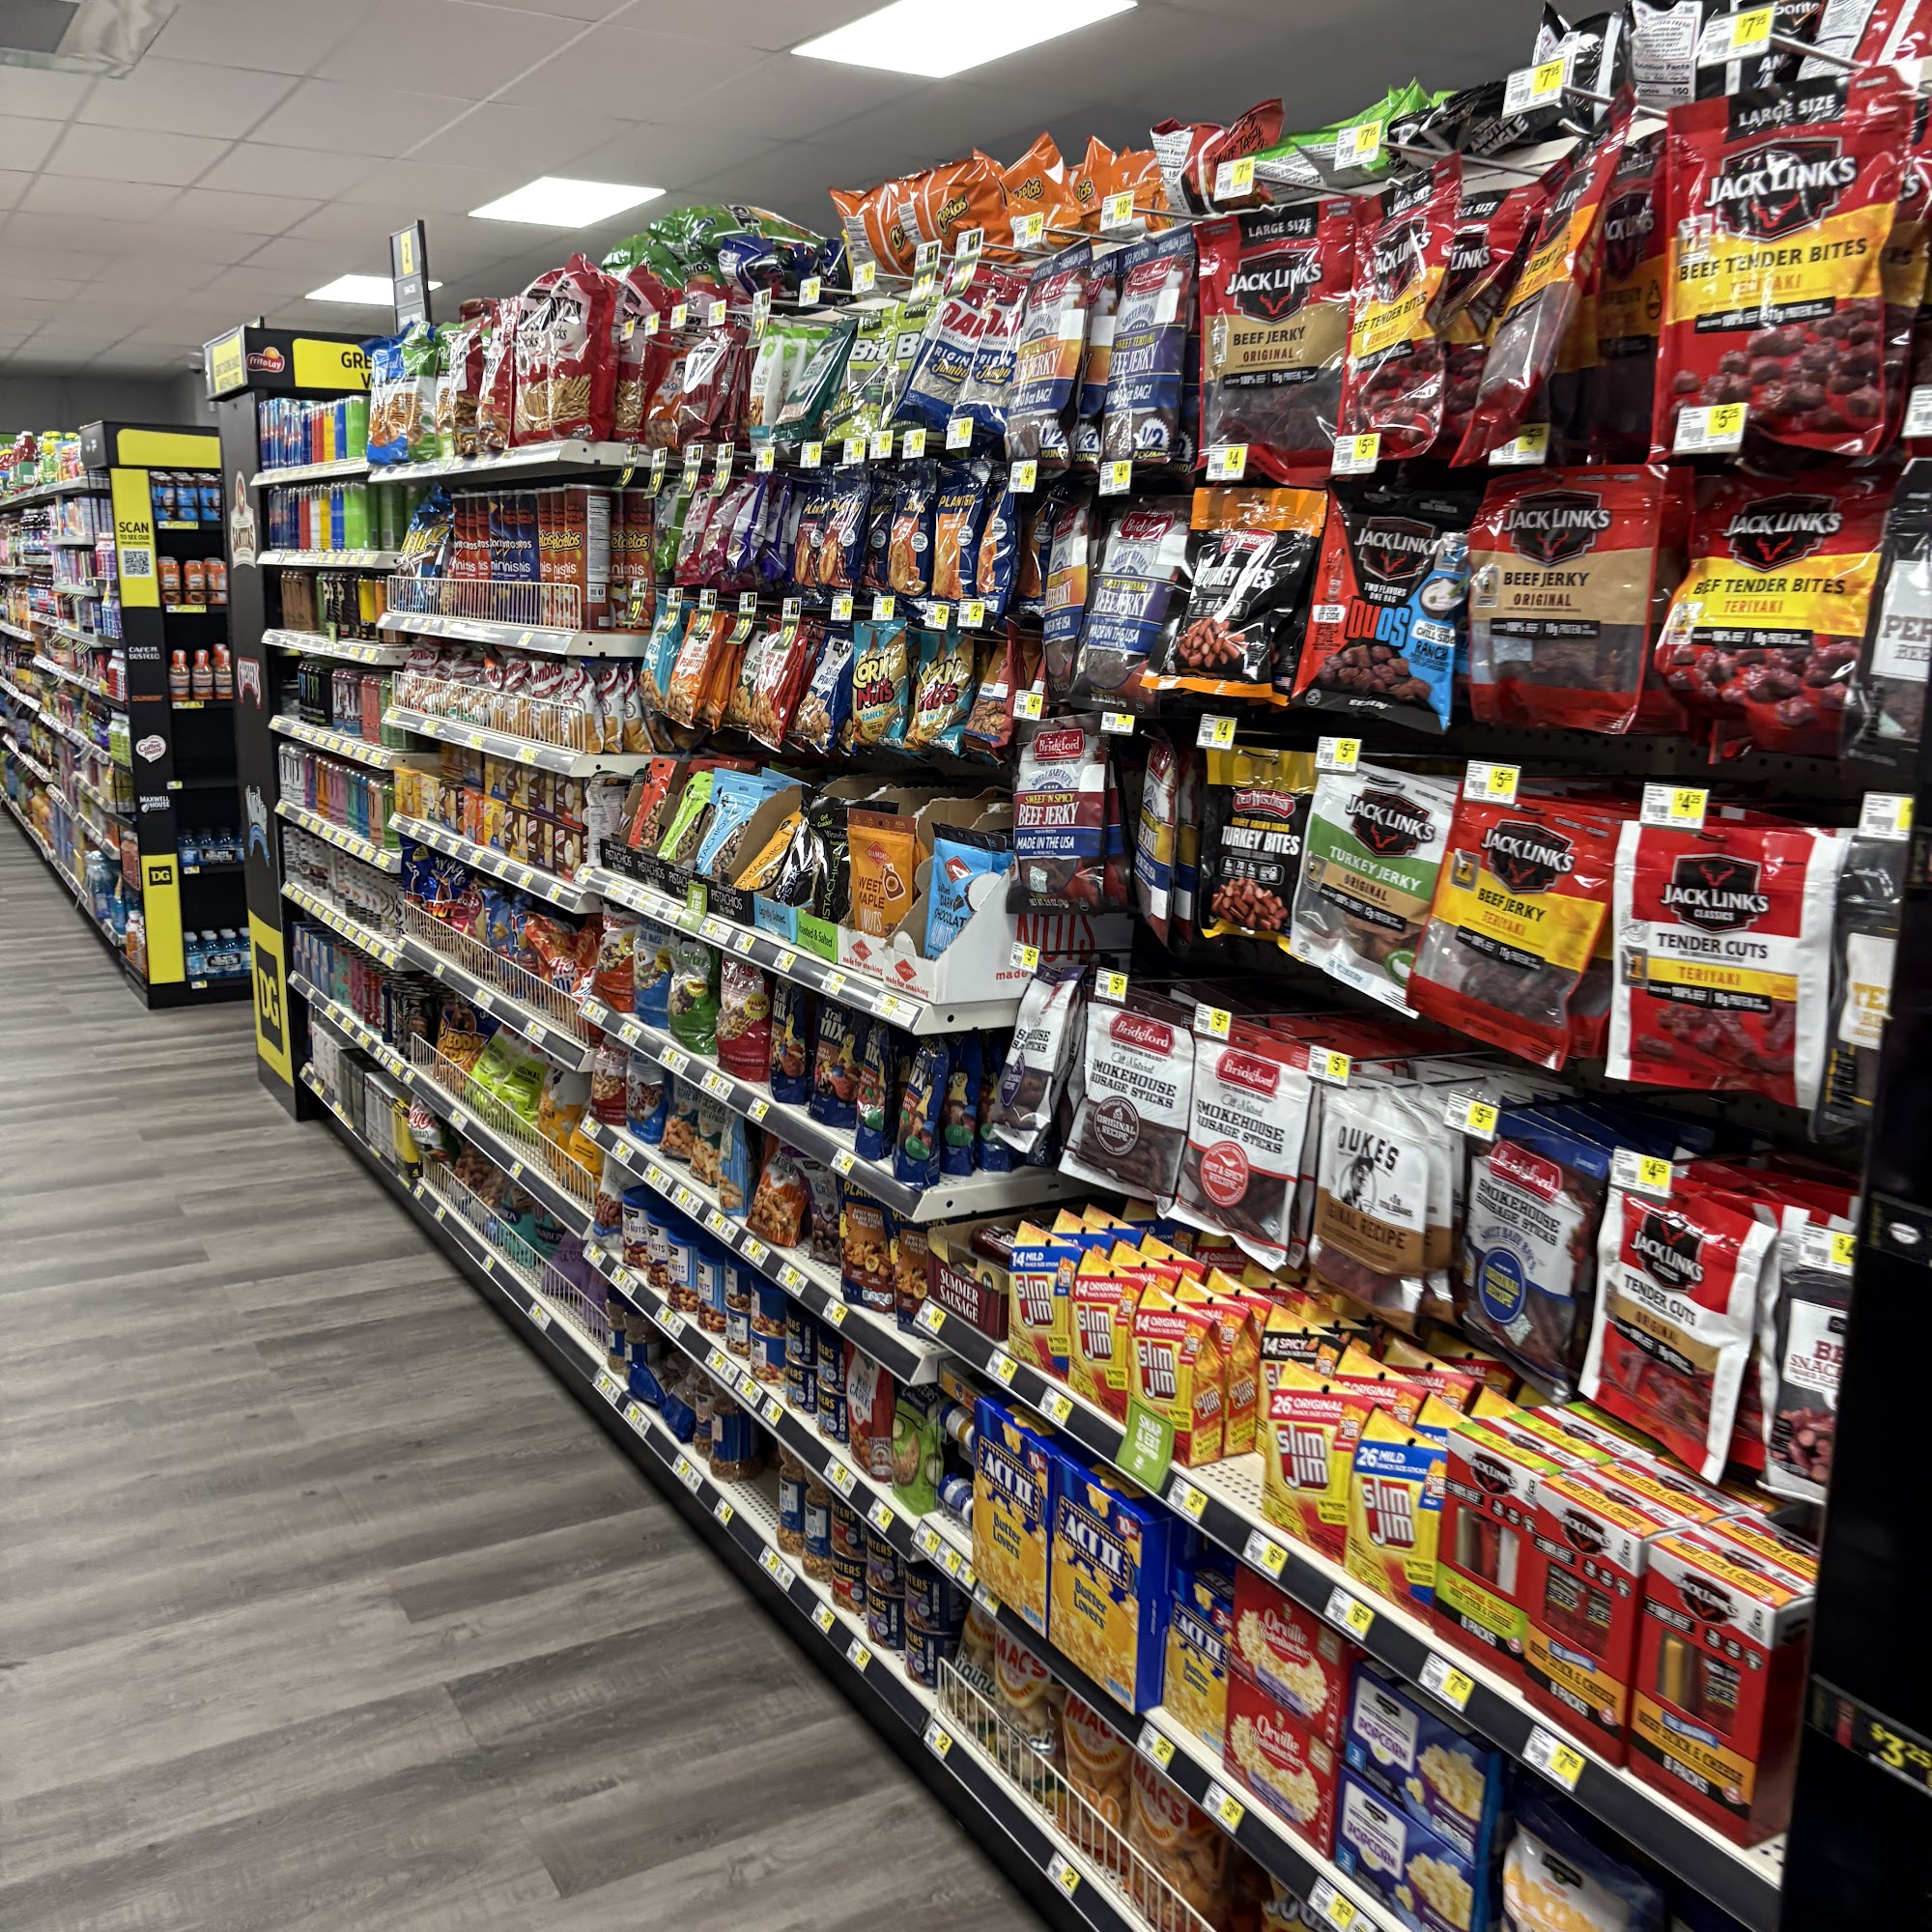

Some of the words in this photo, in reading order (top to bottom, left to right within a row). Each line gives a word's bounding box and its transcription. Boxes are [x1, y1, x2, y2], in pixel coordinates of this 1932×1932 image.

[1739, 106, 1793, 128] LARGE
[1798, 96, 1836, 114] SIZE
[1704, 171, 1768, 209] JACK
[1771, 156, 1857, 190] LINK'S
[1473, 202, 1497, 214] SIZE
[1248, 221, 1284, 238] LARGE
[1287, 217, 1312, 234] SIZE
[404, 242, 410, 265] 2
[1132, 248, 1150, 263] POUND
[1179, 232, 1191, 249] JERKY
[1679, 260, 1720, 280] BEEF
[1725, 249, 1803, 273] TENDER
[1809, 239, 1866, 262] BITES
[1226, 271, 1272, 296] JACK
[1370, 305, 1402, 329] TENDER
[1403, 292, 1428, 317] BITES
[1234, 329, 1263, 346] BEEF
[1265, 327, 1305, 342] JERKY
[1127, 342, 1159, 373] JERKY
[1243, 348, 1293, 363] ORIGINAL
[1229, 448, 1239, 469] $4
[119, 522, 149, 533] SCAN
[1503, 508, 1551, 531] JACK
[1550, 508, 1611, 530] LINK'S
[1723, 514, 1775, 537] JACK
[1776, 511, 1844, 533] LINK'S
[1354, 528, 1392, 550] JACK
[1364, 582, 1378, 595] TWO
[1379, 583, 1407, 597] FLAVORS
[1503, 572, 1539, 586] BEEF
[1539, 572, 1590, 588] JERKY
[1724, 578, 1788, 594] TENDER
[1790, 578, 1845, 595] BITES
[1383, 594, 1397, 604] BAG
[1513, 592, 1571, 608] ORIGINAL
[1723, 600, 1783, 613] TERIYAKI
[1346, 599, 1412, 647] DUOS
[856, 678, 894, 711] NUTS
[861, 709, 884, 723] RANCH
[1218, 721, 1229, 738] $4
[1038, 735, 1080, 753] Bridgford
[139, 795, 170, 805] MAXWELL
[150, 802, 170, 810] HOUSE
[1025, 794, 1046, 805] SWEET
[1054, 793, 1075, 804] SPICY
[1018, 805, 1043, 826] BEEF
[1044, 802, 1080, 825] JERKY
[1345, 794, 1385, 825] JACK
[1385, 810, 1436, 842] LINK'S
[1016, 838, 1034, 850] MADE
[1036, 838, 1043, 849] IN
[1044, 837, 1059, 849] THE
[1060, 836, 1075, 849] USA
[1221, 826, 1264, 850] TURKEY
[1263, 832, 1300, 855] BITES
[1480, 828, 1521, 860] JACK
[1520, 838, 1577, 874] LINK'S
[605, 848, 632, 867] PISTACHIOS
[1329, 845, 1374, 876] TURKEY
[1376, 867, 1422, 893] JERKY
[151, 870, 170, 882] DG
[638, 860, 666, 881] PISTACHIOS
[1343, 873, 1388, 902] ORIGINAL
[1660, 884, 1711, 906] JACK
[1712, 888, 1770, 914] LINK'S
[710, 890, 743, 911] PISTACHIOS
[940, 895, 953, 910] DARK
[1477, 888, 1505, 910] BEEF
[1504, 894, 1547, 923] JERKY
[1693, 908, 1735, 922] CLASSICS
[818, 931, 833, 948] Salted
[1657, 932, 1721, 953] TENDER
[1726, 941, 1769, 959] CUTS
[842, 956, 855, 966] made
[864, 962, 883, 976] snacking
[995, 970, 1028, 980] made
[1678, 965, 1741, 986] TERIYAKI
[886, 975, 896, 985] made
[905, 982, 929, 998] snacking
[258, 968, 280, 1031] DG
[825, 1007, 842, 1024] Trail
[1116, 1020, 1169, 1047] Bridgford
[1131, 1087, 1174, 1109] STICKS
[1097, 1114, 1135, 1134] ORIGINAL
[1102, 1126, 1128, 1141] RECIPE
[1242, 1130, 1283, 1153] STICKS
[1338, 1125, 1399, 1171] DUKE'S
[1360, 1217, 1406, 1250] RECIPE
[1011, 1252, 1025, 1265] 14
[1025, 1252, 1044, 1262] MILD
[1631, 1231, 1665, 1263] JACK
[1664, 1247, 1704, 1282] LINK'S
[940, 1267, 979, 1306] SUMMER
[1074, 1280, 1088, 1296] 14
[1089, 1281, 1122, 1294] ORIGINAL
[939, 1287, 979, 1323] SAUSAGE
[1625, 1274, 1666, 1309] TENDER
[1669, 1299, 1695, 1326] CUTS
[1135, 1314, 1150, 1331] 14
[1151, 1317, 1186, 1331] ORIGINAL
[1262, 1337, 1277, 1354] 14
[1279, 1337, 1308, 1350] SPICY
[1271, 1396, 1292, 1415] 26
[1293, 1398, 1343, 1412] ORIGINAL
[1030, 1452, 1040, 1466] 10
[1356, 1446, 1378, 1466] 26
[1378, 1451, 1406, 1463] MILD
[984, 1452, 1013, 1492] ACT
[1015, 1476, 1033, 1506] II
[993, 1512, 1021, 1546] Butter
[1119, 1517, 1130, 1533] 10
[993, 1526, 1020, 1560] Lovers
[1065, 1514, 1099, 1556] ACT
[1101, 1544, 1122, 1574] II
[1074, 1578, 1107, 1614] Butter
[1073, 1596, 1106, 1630] Lovers
[1264, 1607, 1306, 1641] Orville
[1177, 1610, 1203, 1644] ACT
[1202, 1631, 1223, 1658] II
[996, 1634, 1048, 1680] MAC'S
[1183, 1657, 1210, 1686] Butter
[1183, 1671, 1208, 1697] Lovers
[1256, 1714, 1299, 1753] Orville
